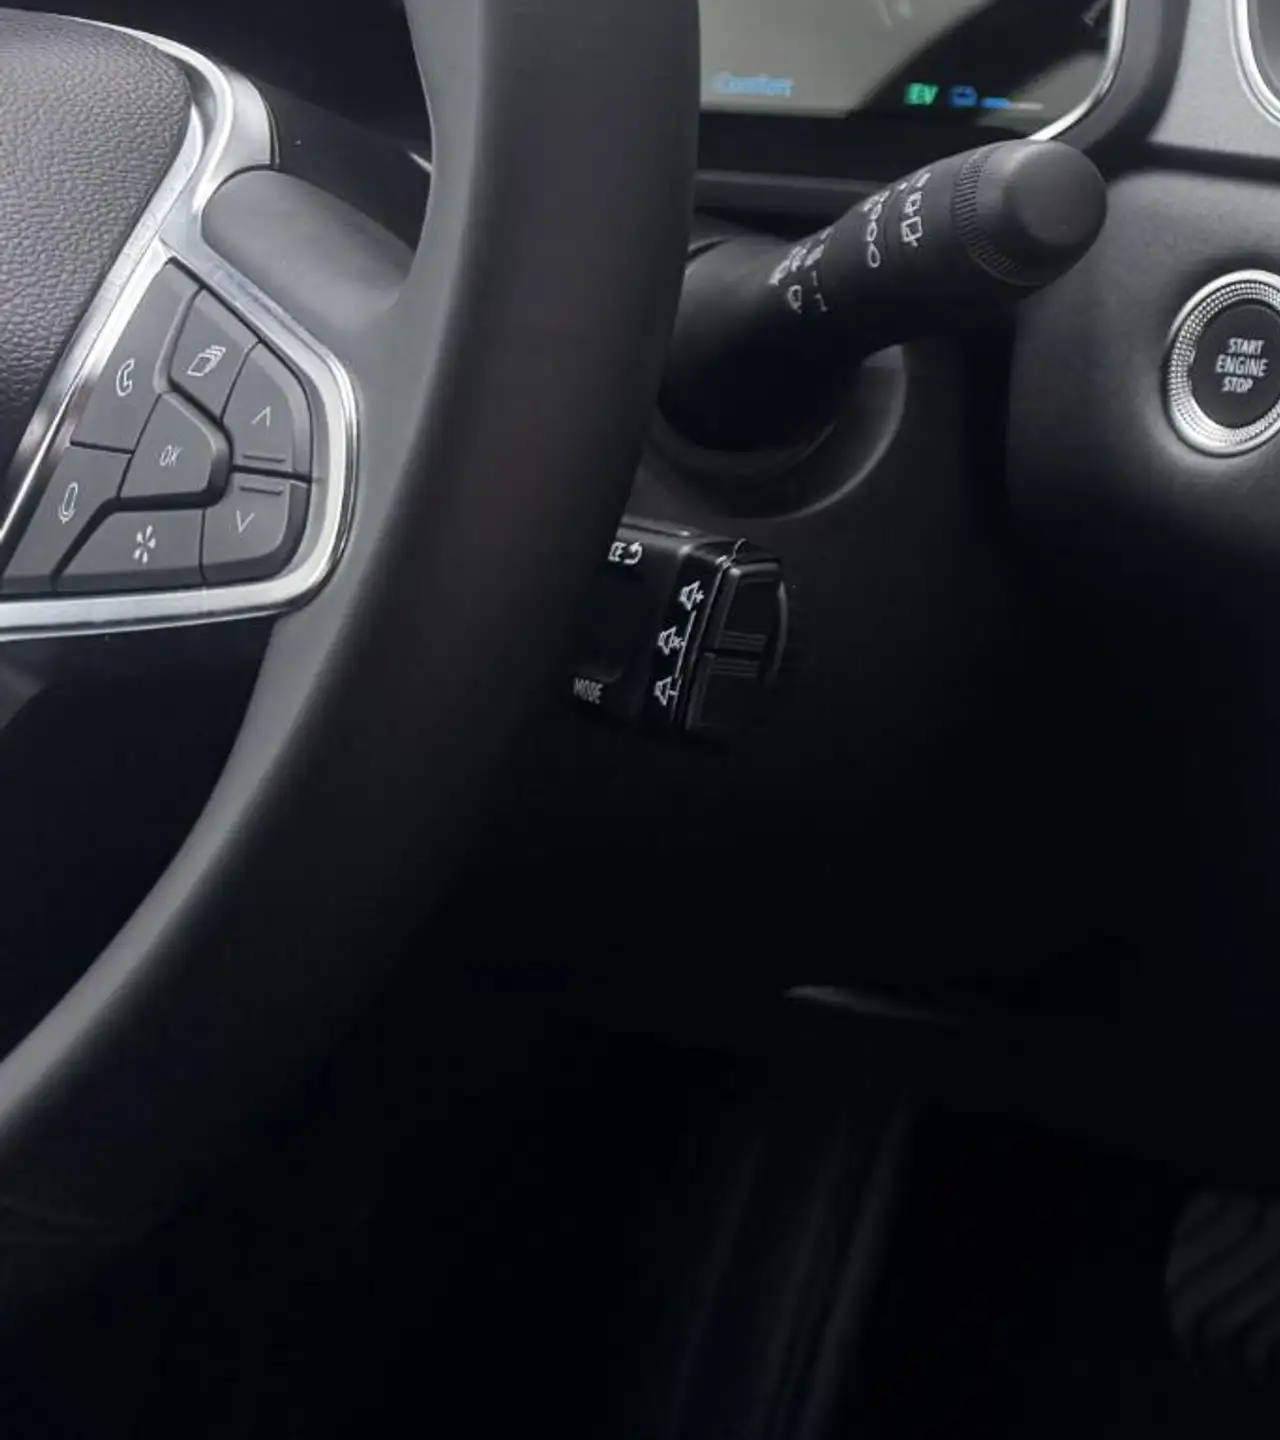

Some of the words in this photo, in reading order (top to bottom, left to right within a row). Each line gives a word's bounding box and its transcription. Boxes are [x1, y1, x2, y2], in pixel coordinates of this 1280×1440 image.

[1225, 337, 1263, 355] START
[1215, 355, 1269, 377] ENGINE
[1222, 375, 1253, 393] STOP
[158, 444, 183, 467] OK
